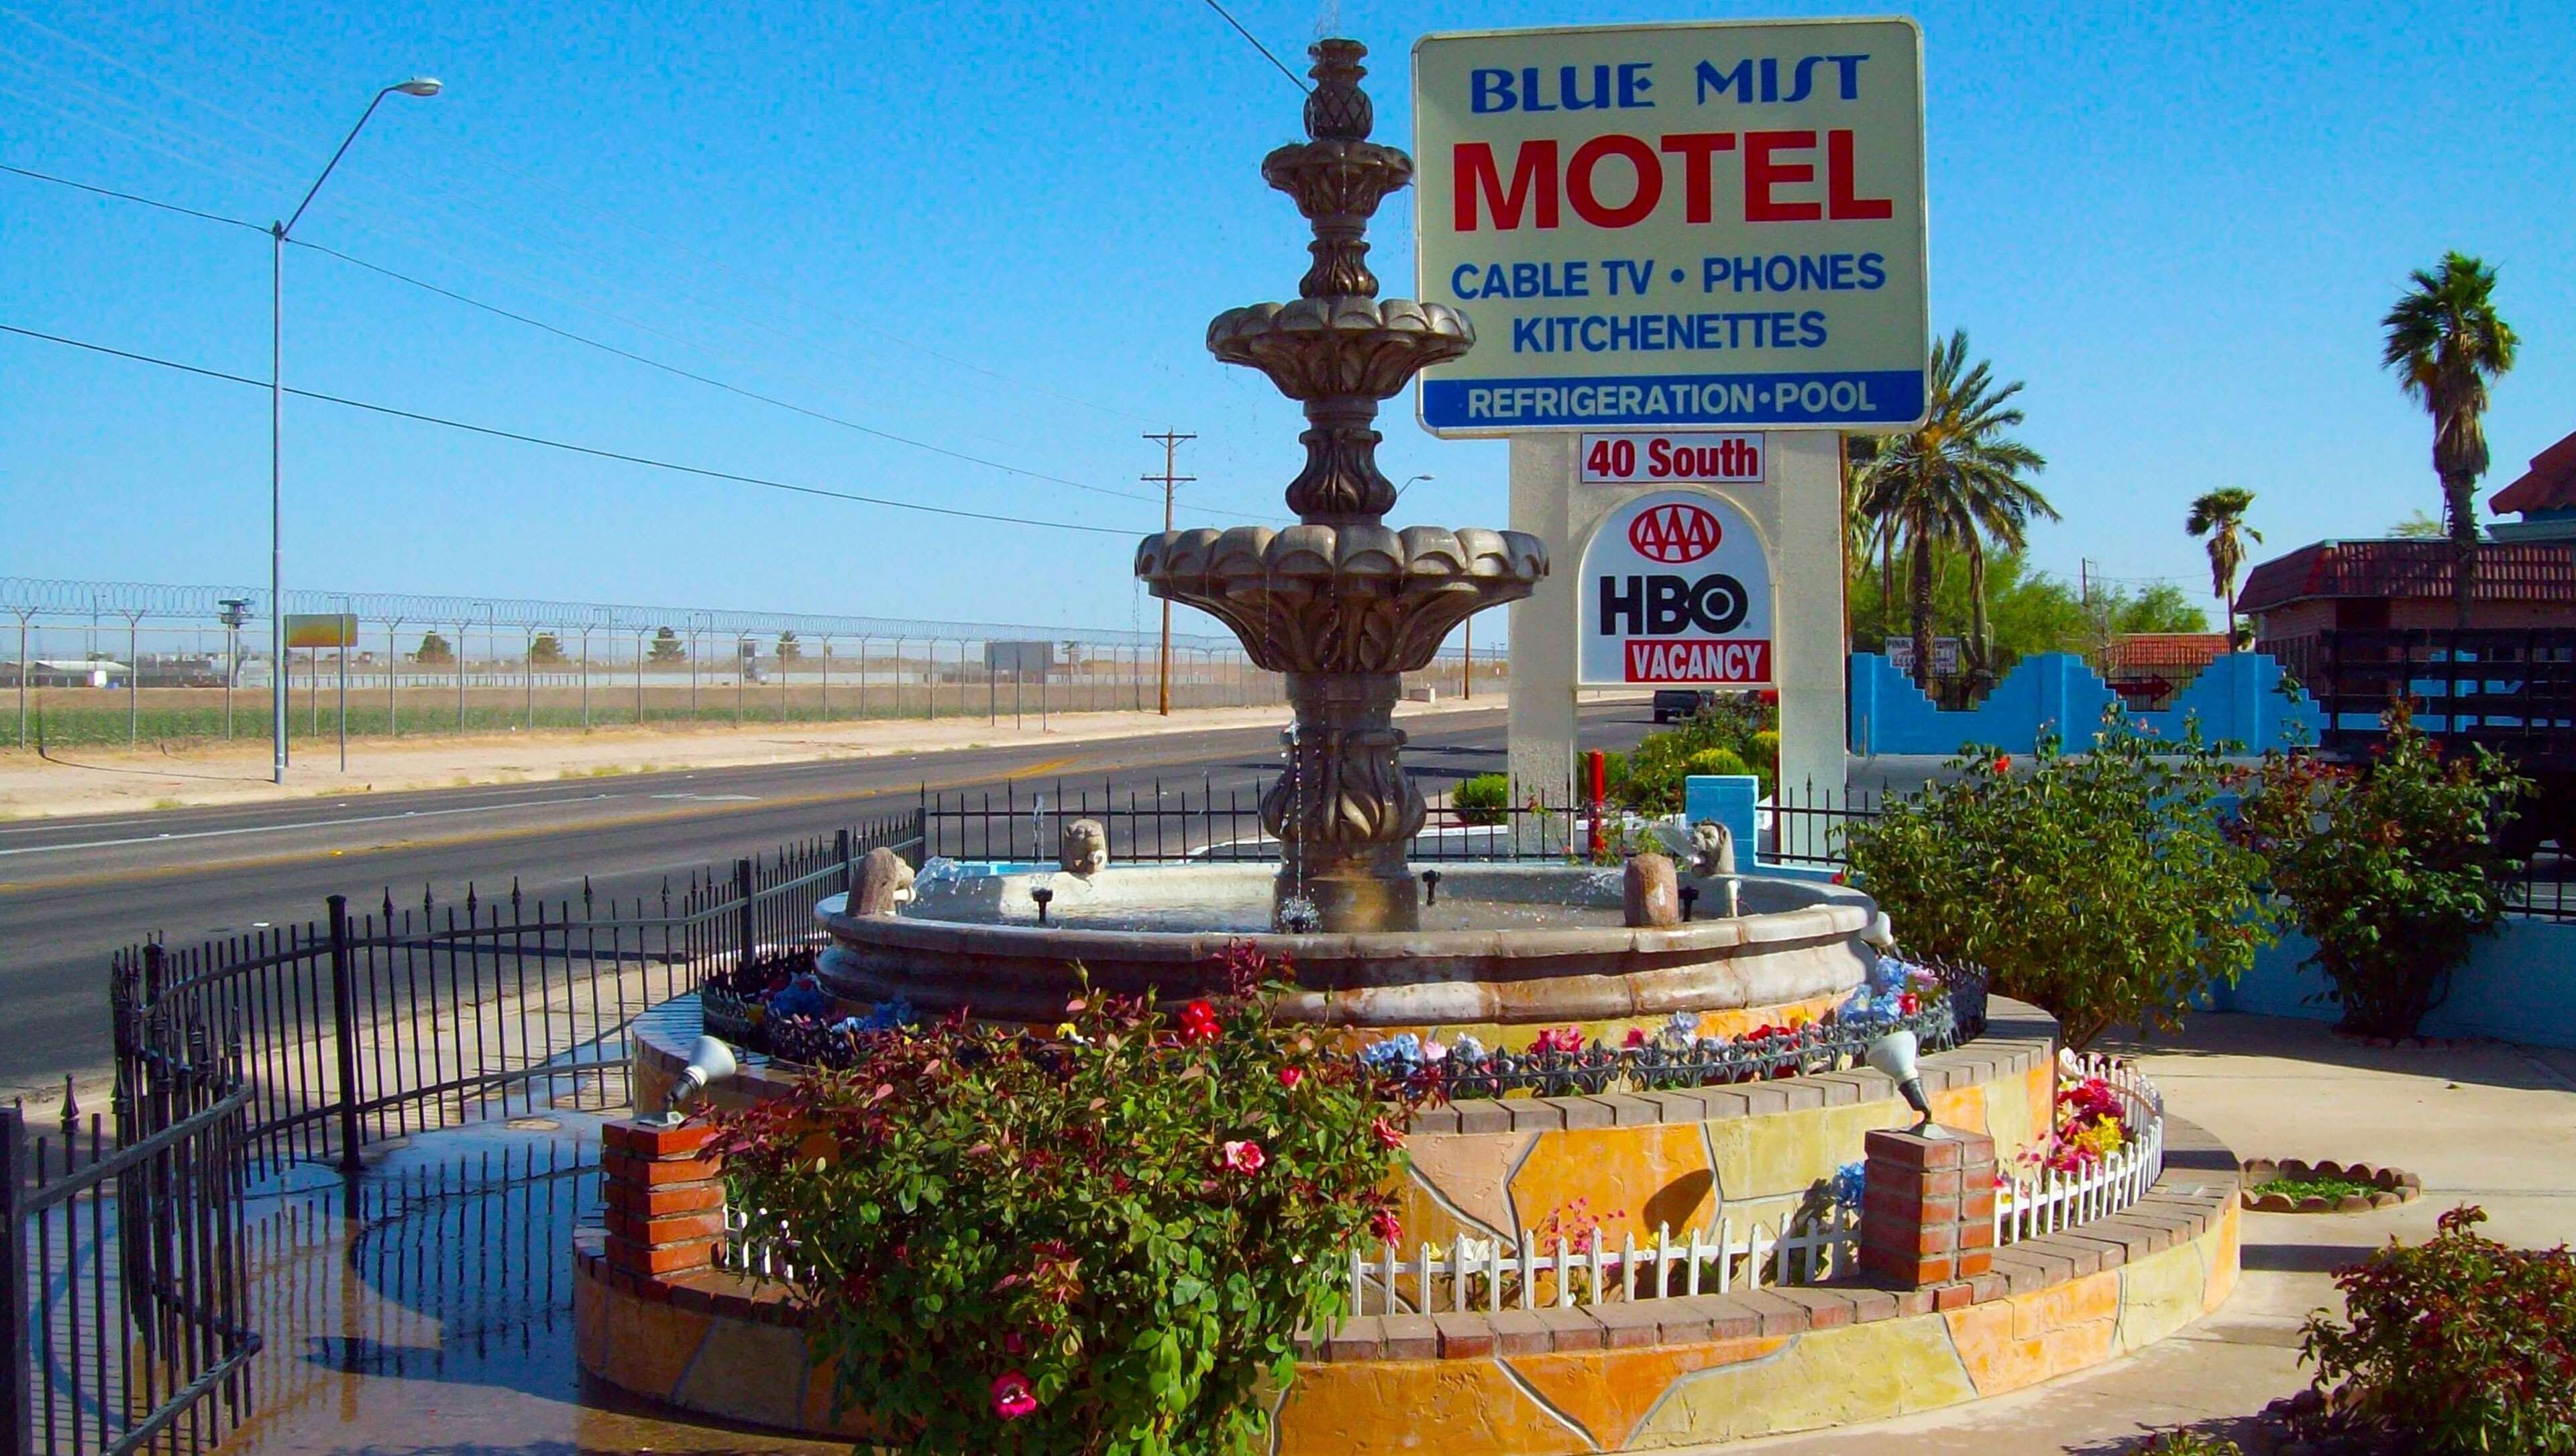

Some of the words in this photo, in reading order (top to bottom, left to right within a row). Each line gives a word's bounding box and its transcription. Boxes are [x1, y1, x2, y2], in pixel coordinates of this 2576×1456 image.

[1470, 63, 1656, 114] BLUE
[1695, 54, 1871, 105] MIST
[1454, 129, 1892, 231] MOTEL
[1452, 261, 1589, 300] CABLE
[1601, 259, 1654, 296] TV
[1703, 252, 1886, 293] PHONES
[1513, 311, 1827, 353] KITCHENETTES
[1587, 439, 1635, 478] 40
[1648, 437, 1758, 477] South
[1634, 505, 1719, 562] AAA
[1600, 574, 1748, 635] HBO
[1632, 644, 1762, 680] VACANCY
